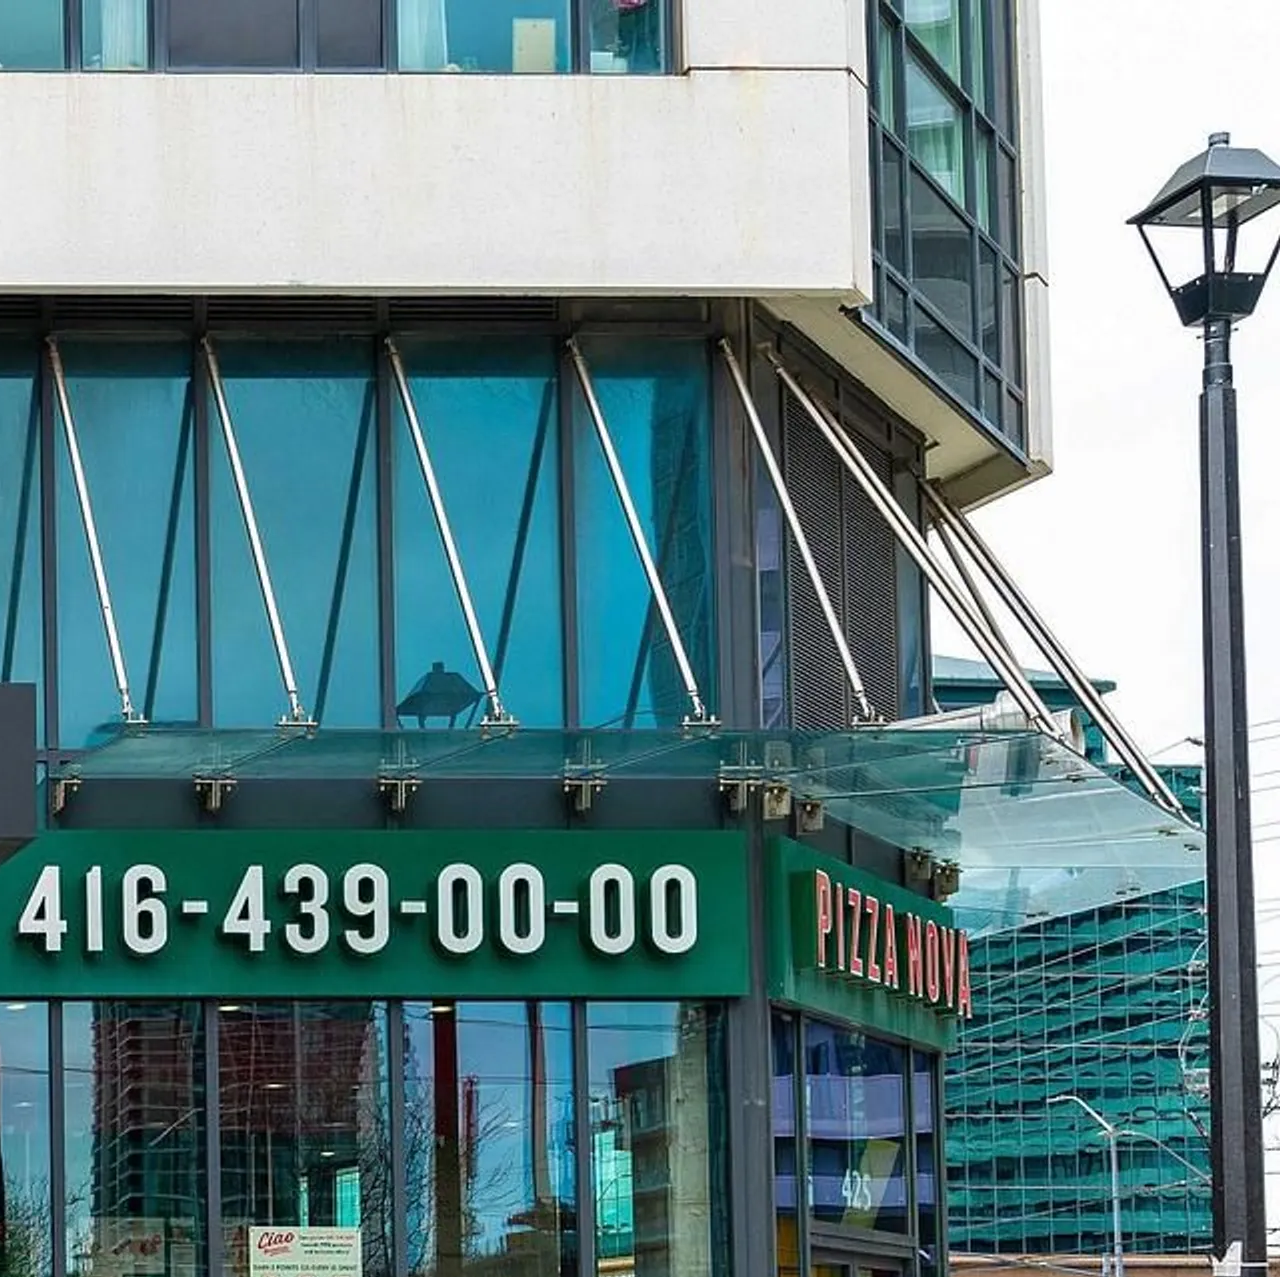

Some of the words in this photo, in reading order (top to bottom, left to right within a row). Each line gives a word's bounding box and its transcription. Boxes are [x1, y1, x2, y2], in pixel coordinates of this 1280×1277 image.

[17, 862, 698, 955] 416-439-00-00
[816, 869, 899, 989] PIZZA
[907, 912, 972, 1018] NOVA
[842, 1168, 872, 1212] 425
[257, 1232, 295, 1250] Ciao
